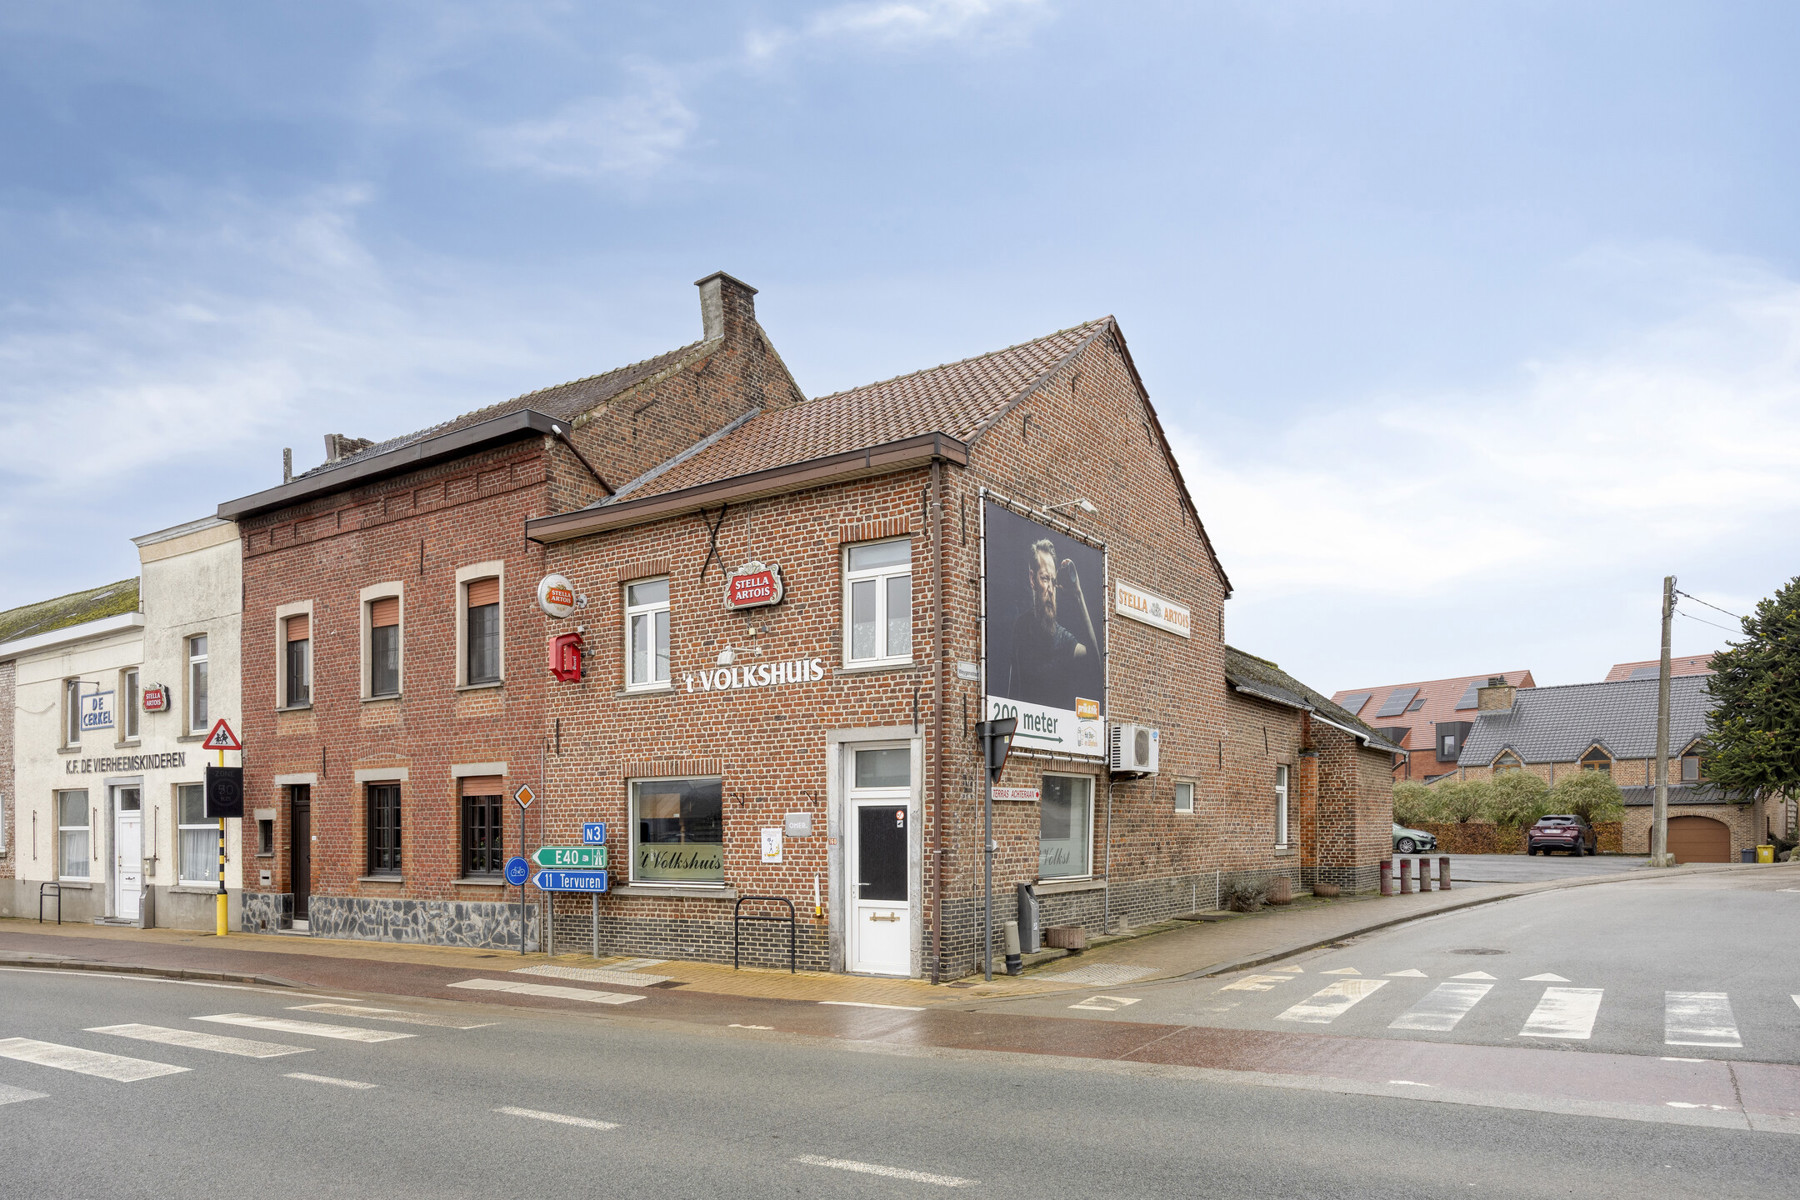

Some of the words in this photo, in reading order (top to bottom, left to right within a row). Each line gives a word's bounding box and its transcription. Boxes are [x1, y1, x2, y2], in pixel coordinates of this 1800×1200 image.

[735, 576, 769, 590] STELLA
[551, 589, 572, 599] STELLA
[551, 595, 572, 604] ARTOIS
[735, 586, 770, 601] ARTOIS
[1118, 588, 1148, 614] STELLA
[1164, 607, 1189, 629] ARTOIS
[683, 673, 694, 692] 't
[700, 658, 824, 691] VOLKSHUIS
[92, 697, 104, 711] DE
[83, 710, 113, 726] CERKEL
[1023, 712, 1058, 734] meter
[66, 760, 80, 774] K.F.
[81, 758, 92, 773] DE
[93, 751, 186, 772] VIERHEEMSKINDEREN
[993, 789, 1009, 798] TERRAS
[586, 826, 601, 841] N3
[555, 850, 579, 865] E40
[652, 850, 721, 870] Volkshuis
[545, 873, 553, 887] 11
[560, 873, 600, 889] Tervuren
